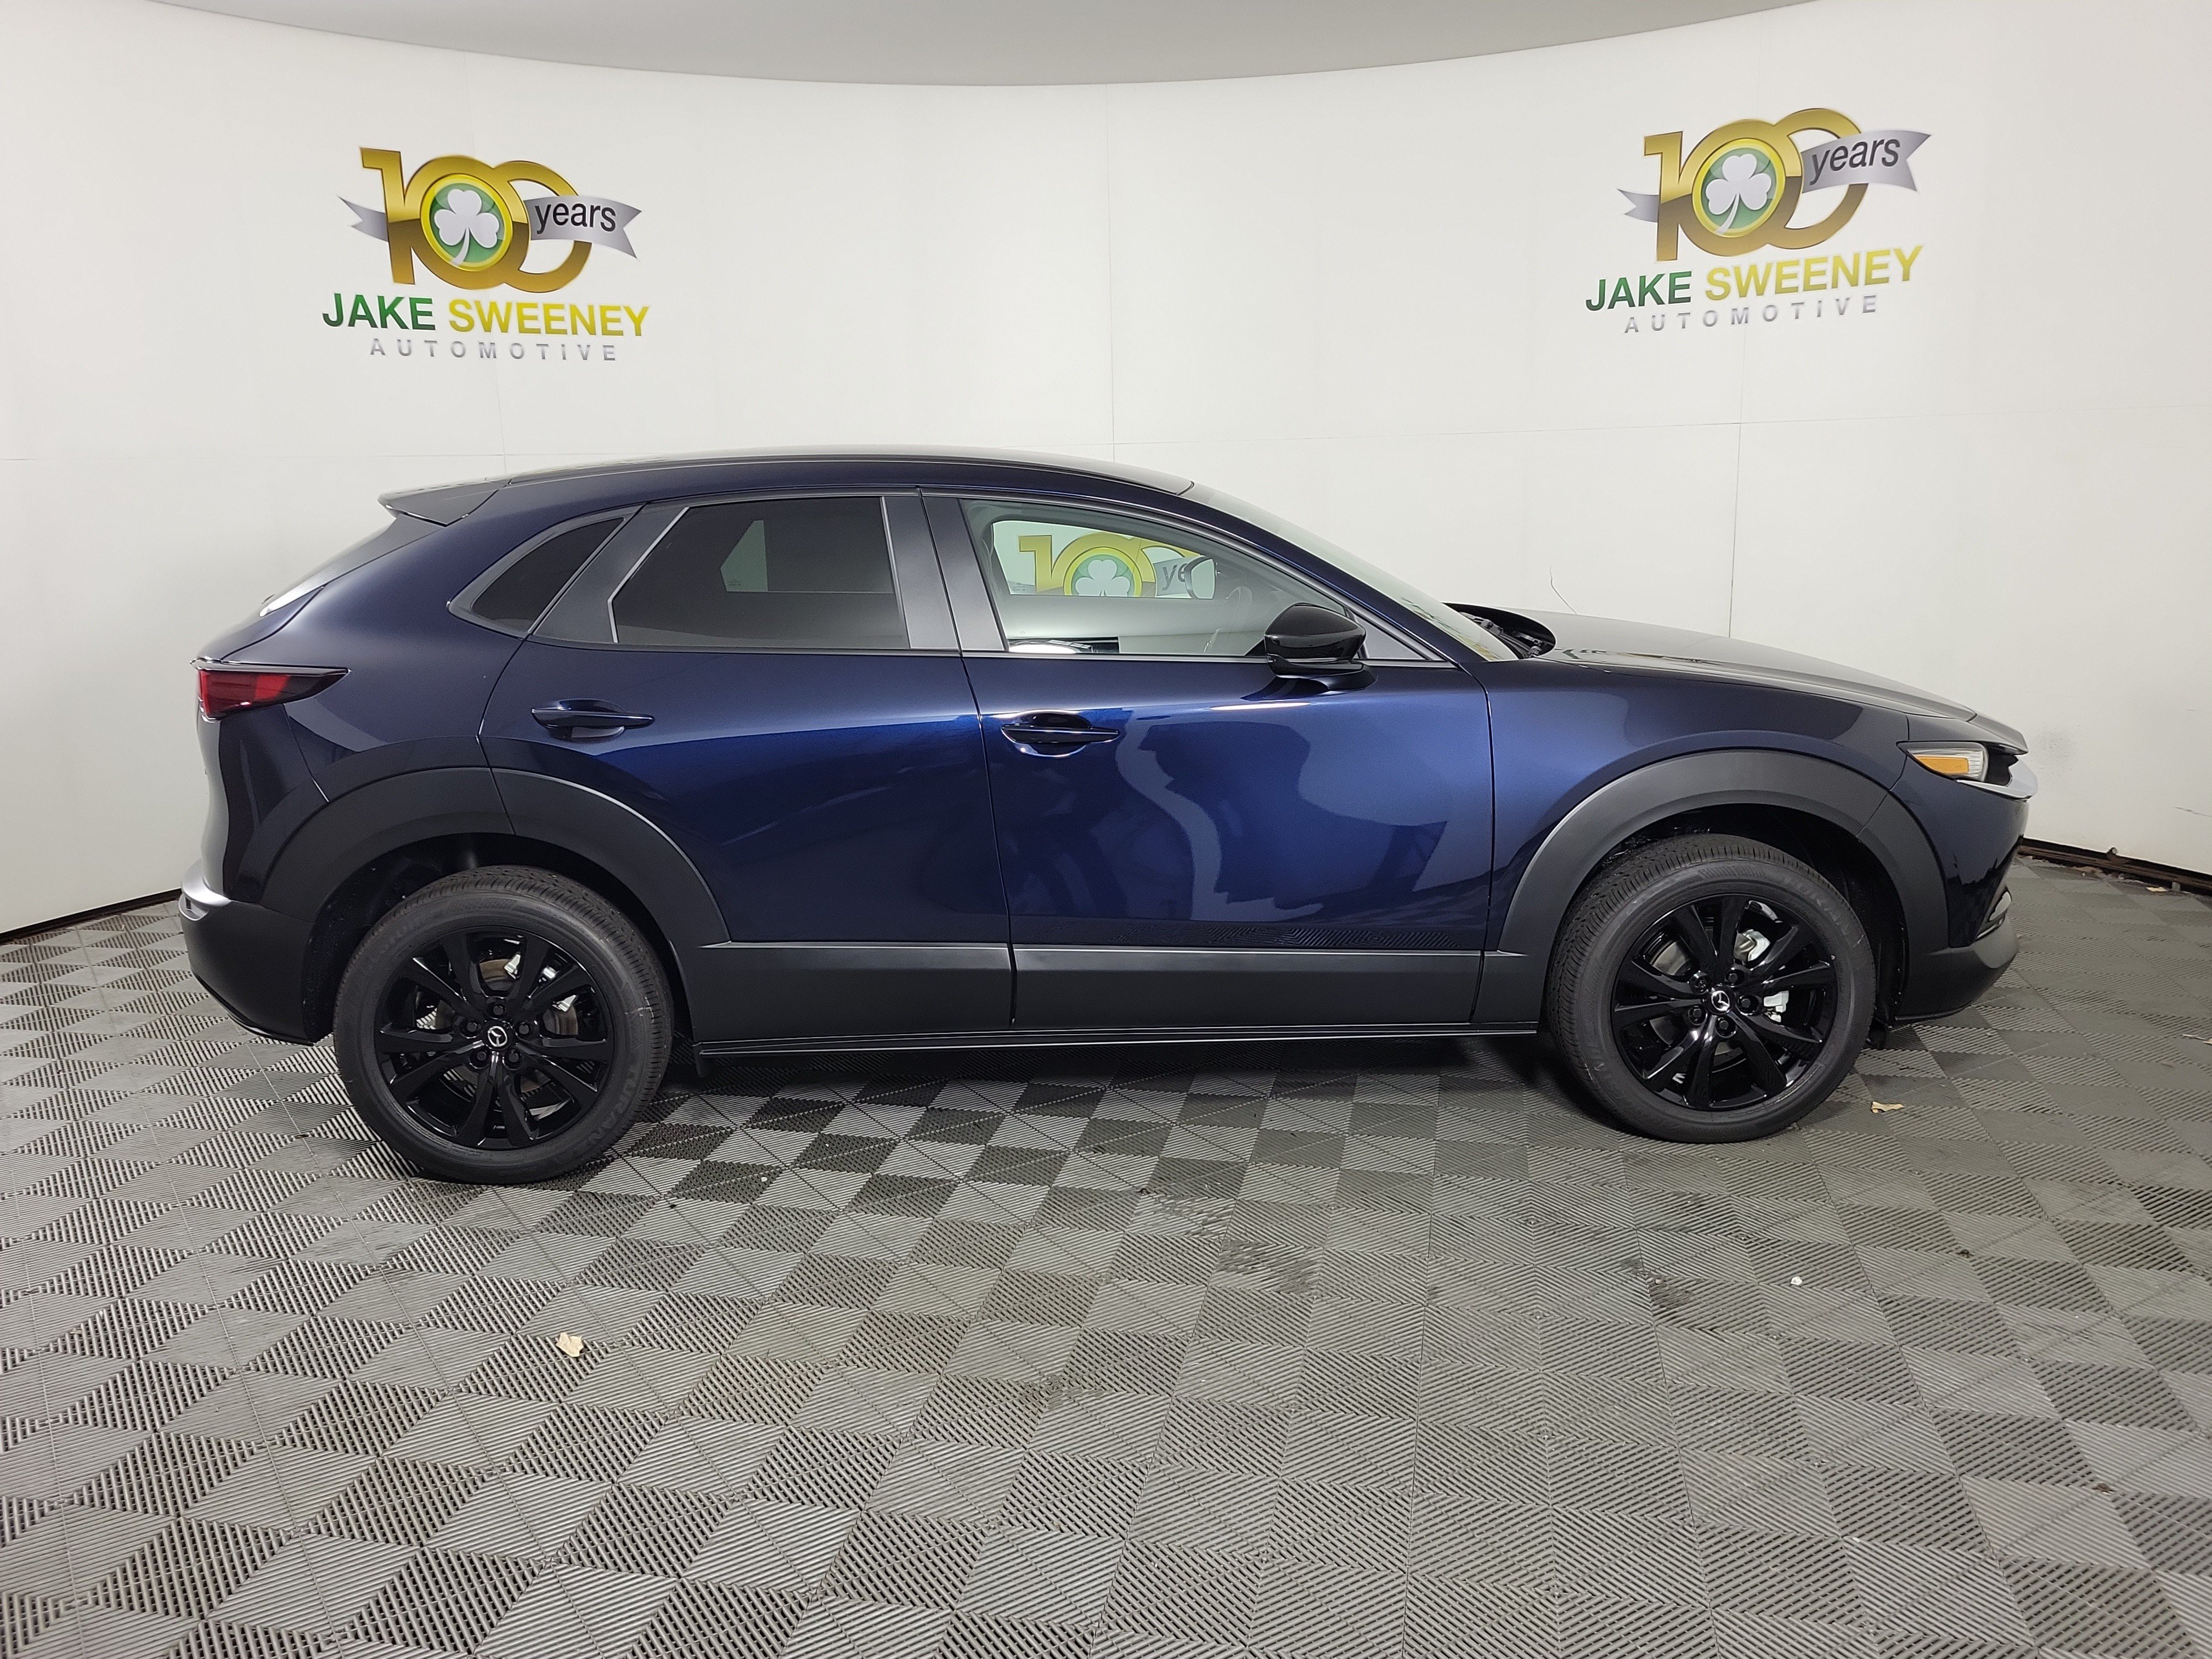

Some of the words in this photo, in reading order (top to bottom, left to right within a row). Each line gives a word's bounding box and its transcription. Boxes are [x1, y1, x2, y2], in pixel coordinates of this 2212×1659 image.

[1644, 108, 1869, 262] 100
[1810, 138, 1900, 185] years
[359, 147, 592, 294] 100
[534, 202, 617, 234] years
[1585, 270, 1692, 311] JAKE
[1705, 245, 1923, 301] SWEENEY
[322, 293, 436, 330] JAKE
[449, 298, 649, 336] SWEENEY
[1624, 295, 1876, 333] AUTOMOTIVE
[370, 338, 615, 360] AUTOMOTIVE
